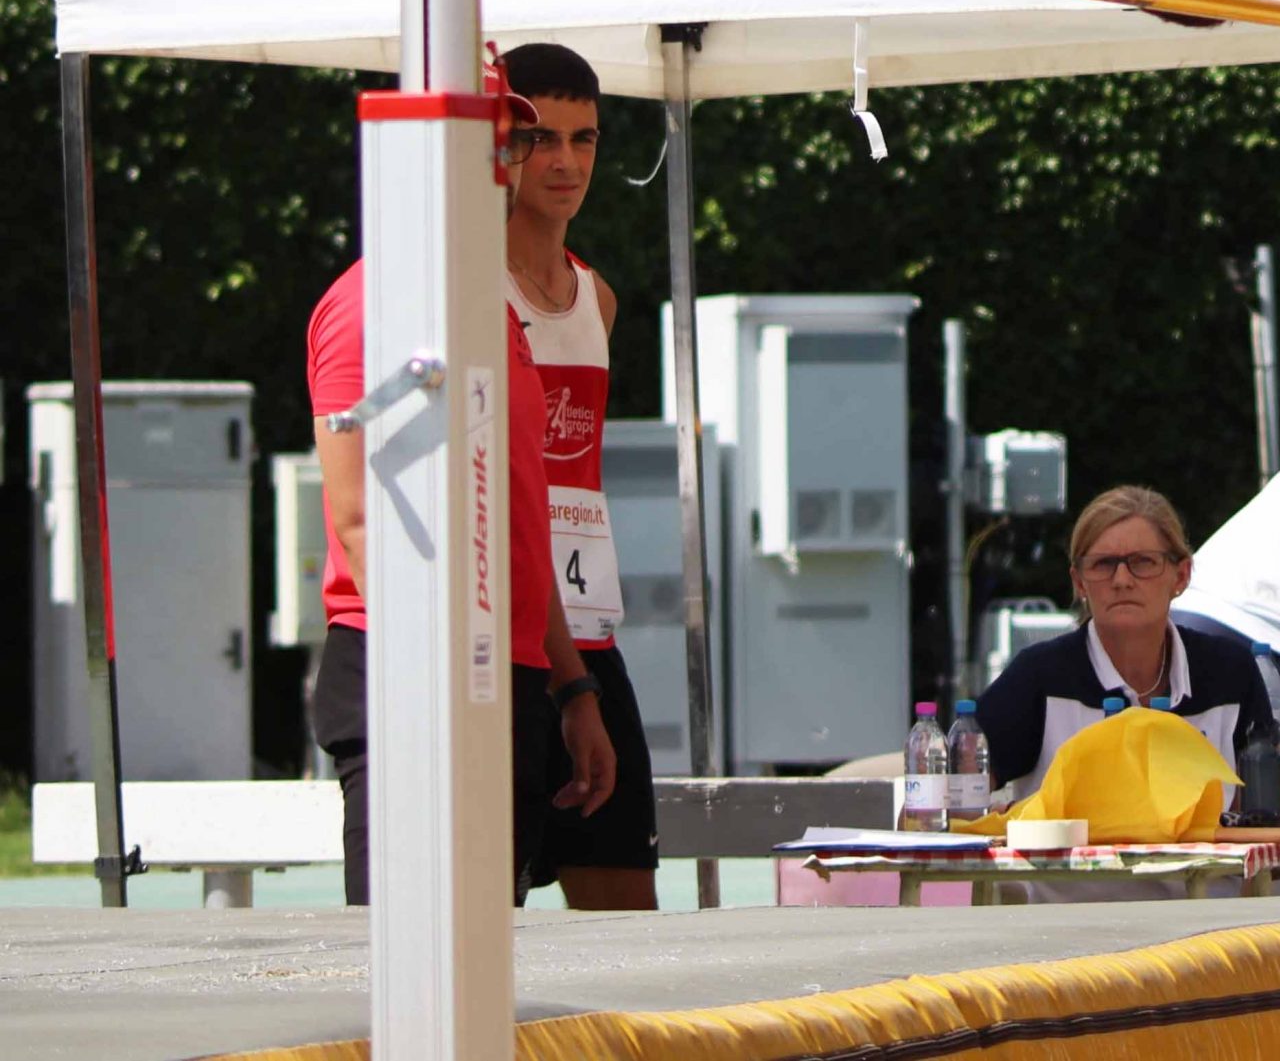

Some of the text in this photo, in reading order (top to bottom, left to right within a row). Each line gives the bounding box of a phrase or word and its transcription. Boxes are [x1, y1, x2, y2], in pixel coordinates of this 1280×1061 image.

[473, 445, 492, 614] polanik
[549, 501, 605, 525] aregion.it
[566, 549, 587, 595] 4
